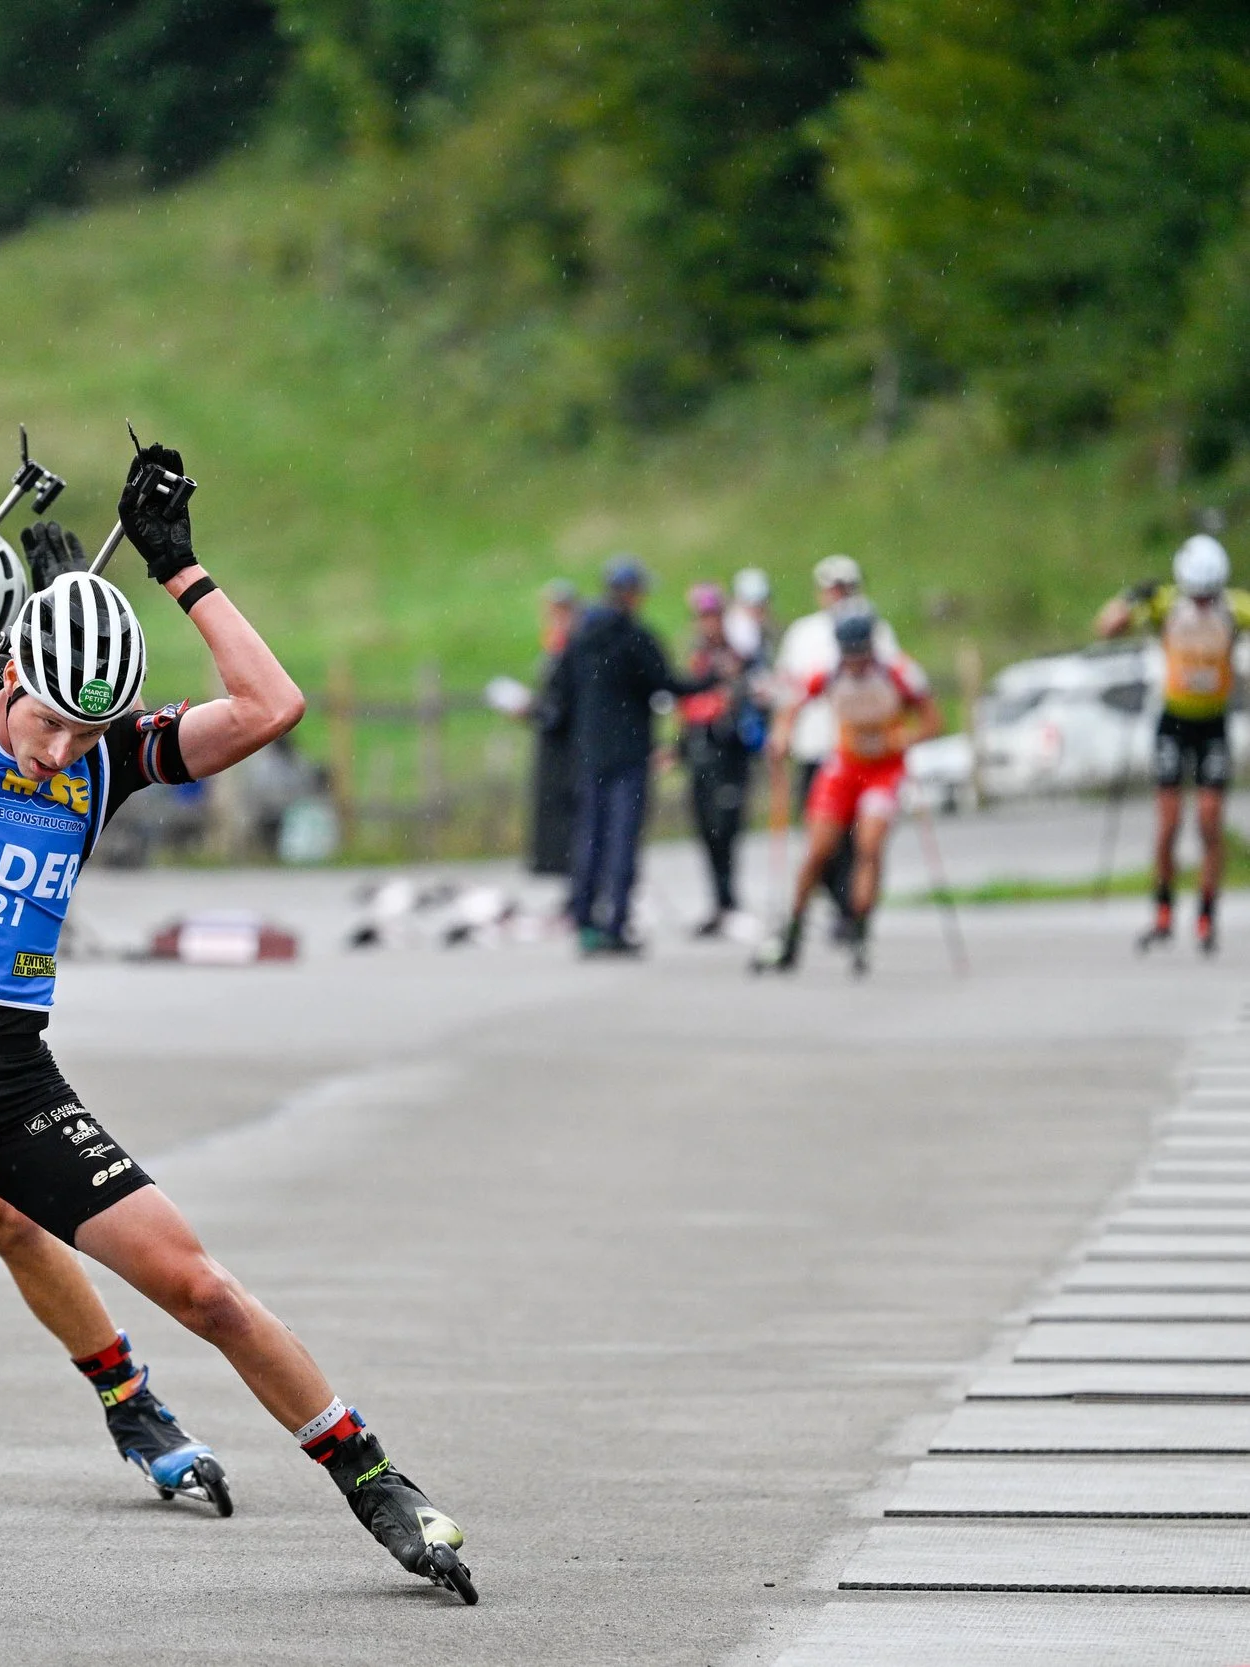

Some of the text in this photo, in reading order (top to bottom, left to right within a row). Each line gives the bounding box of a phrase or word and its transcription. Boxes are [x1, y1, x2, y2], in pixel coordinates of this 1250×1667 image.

[84, 688, 111, 698] MARCEL
[85, 694, 109, 705] PETITE
[6, 810, 86, 832] CONSTRUCTION
[15, 965, 25, 975] DU
